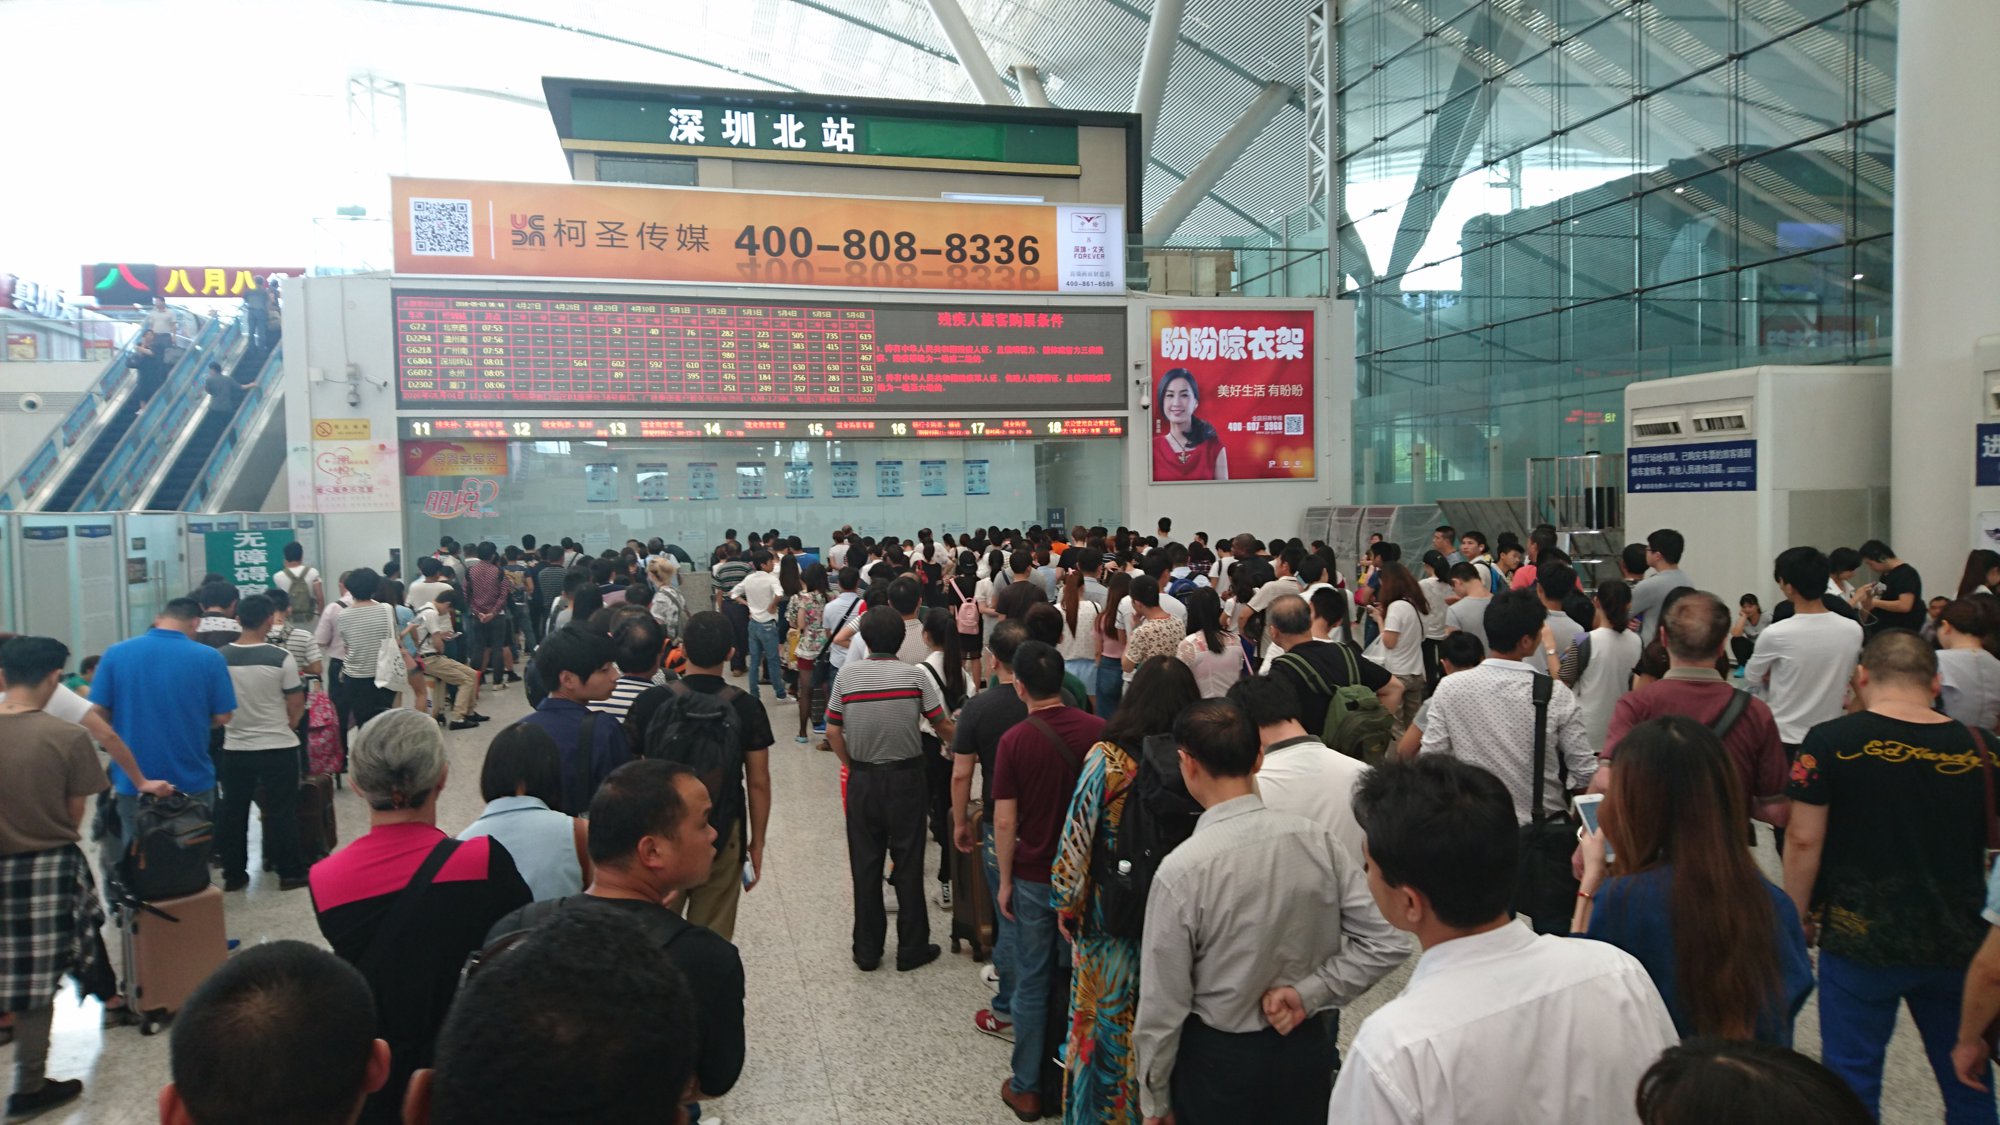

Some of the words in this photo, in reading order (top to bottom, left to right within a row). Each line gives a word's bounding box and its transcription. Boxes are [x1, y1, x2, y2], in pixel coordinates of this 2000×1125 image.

[668, 107, 855, 152] 深圳北站
[554, 218, 710, 254] 柯圣传媒
[735, 224, 1040, 266] 400-808-8336
[164, 268, 257, 295] 八月八
[937, 312, 1064, 328] 残疾人旅客购票条件
[1161, 326, 1304, 360] 盼盼晾衣架
[611, 360, 625, 368] 602
[723, 373, 736, 381] 476
[723, 384, 736, 392] 251
[1217, 384, 1265, 398] 美好生活
[1268, 384, 1304, 397] 有盼盼
[412, 422, 430, 436] 11
[513, 422, 531, 436] 12
[609, 422, 627, 436] 13
[704, 423, 721, 435] 14
[807, 423, 824, 436] 15
[891, 423, 907, 436] 16
[971, 423, 985, 434] 17
[1047, 421, 1062, 434] 18
[1863, 739, 1901, 758] Ed
